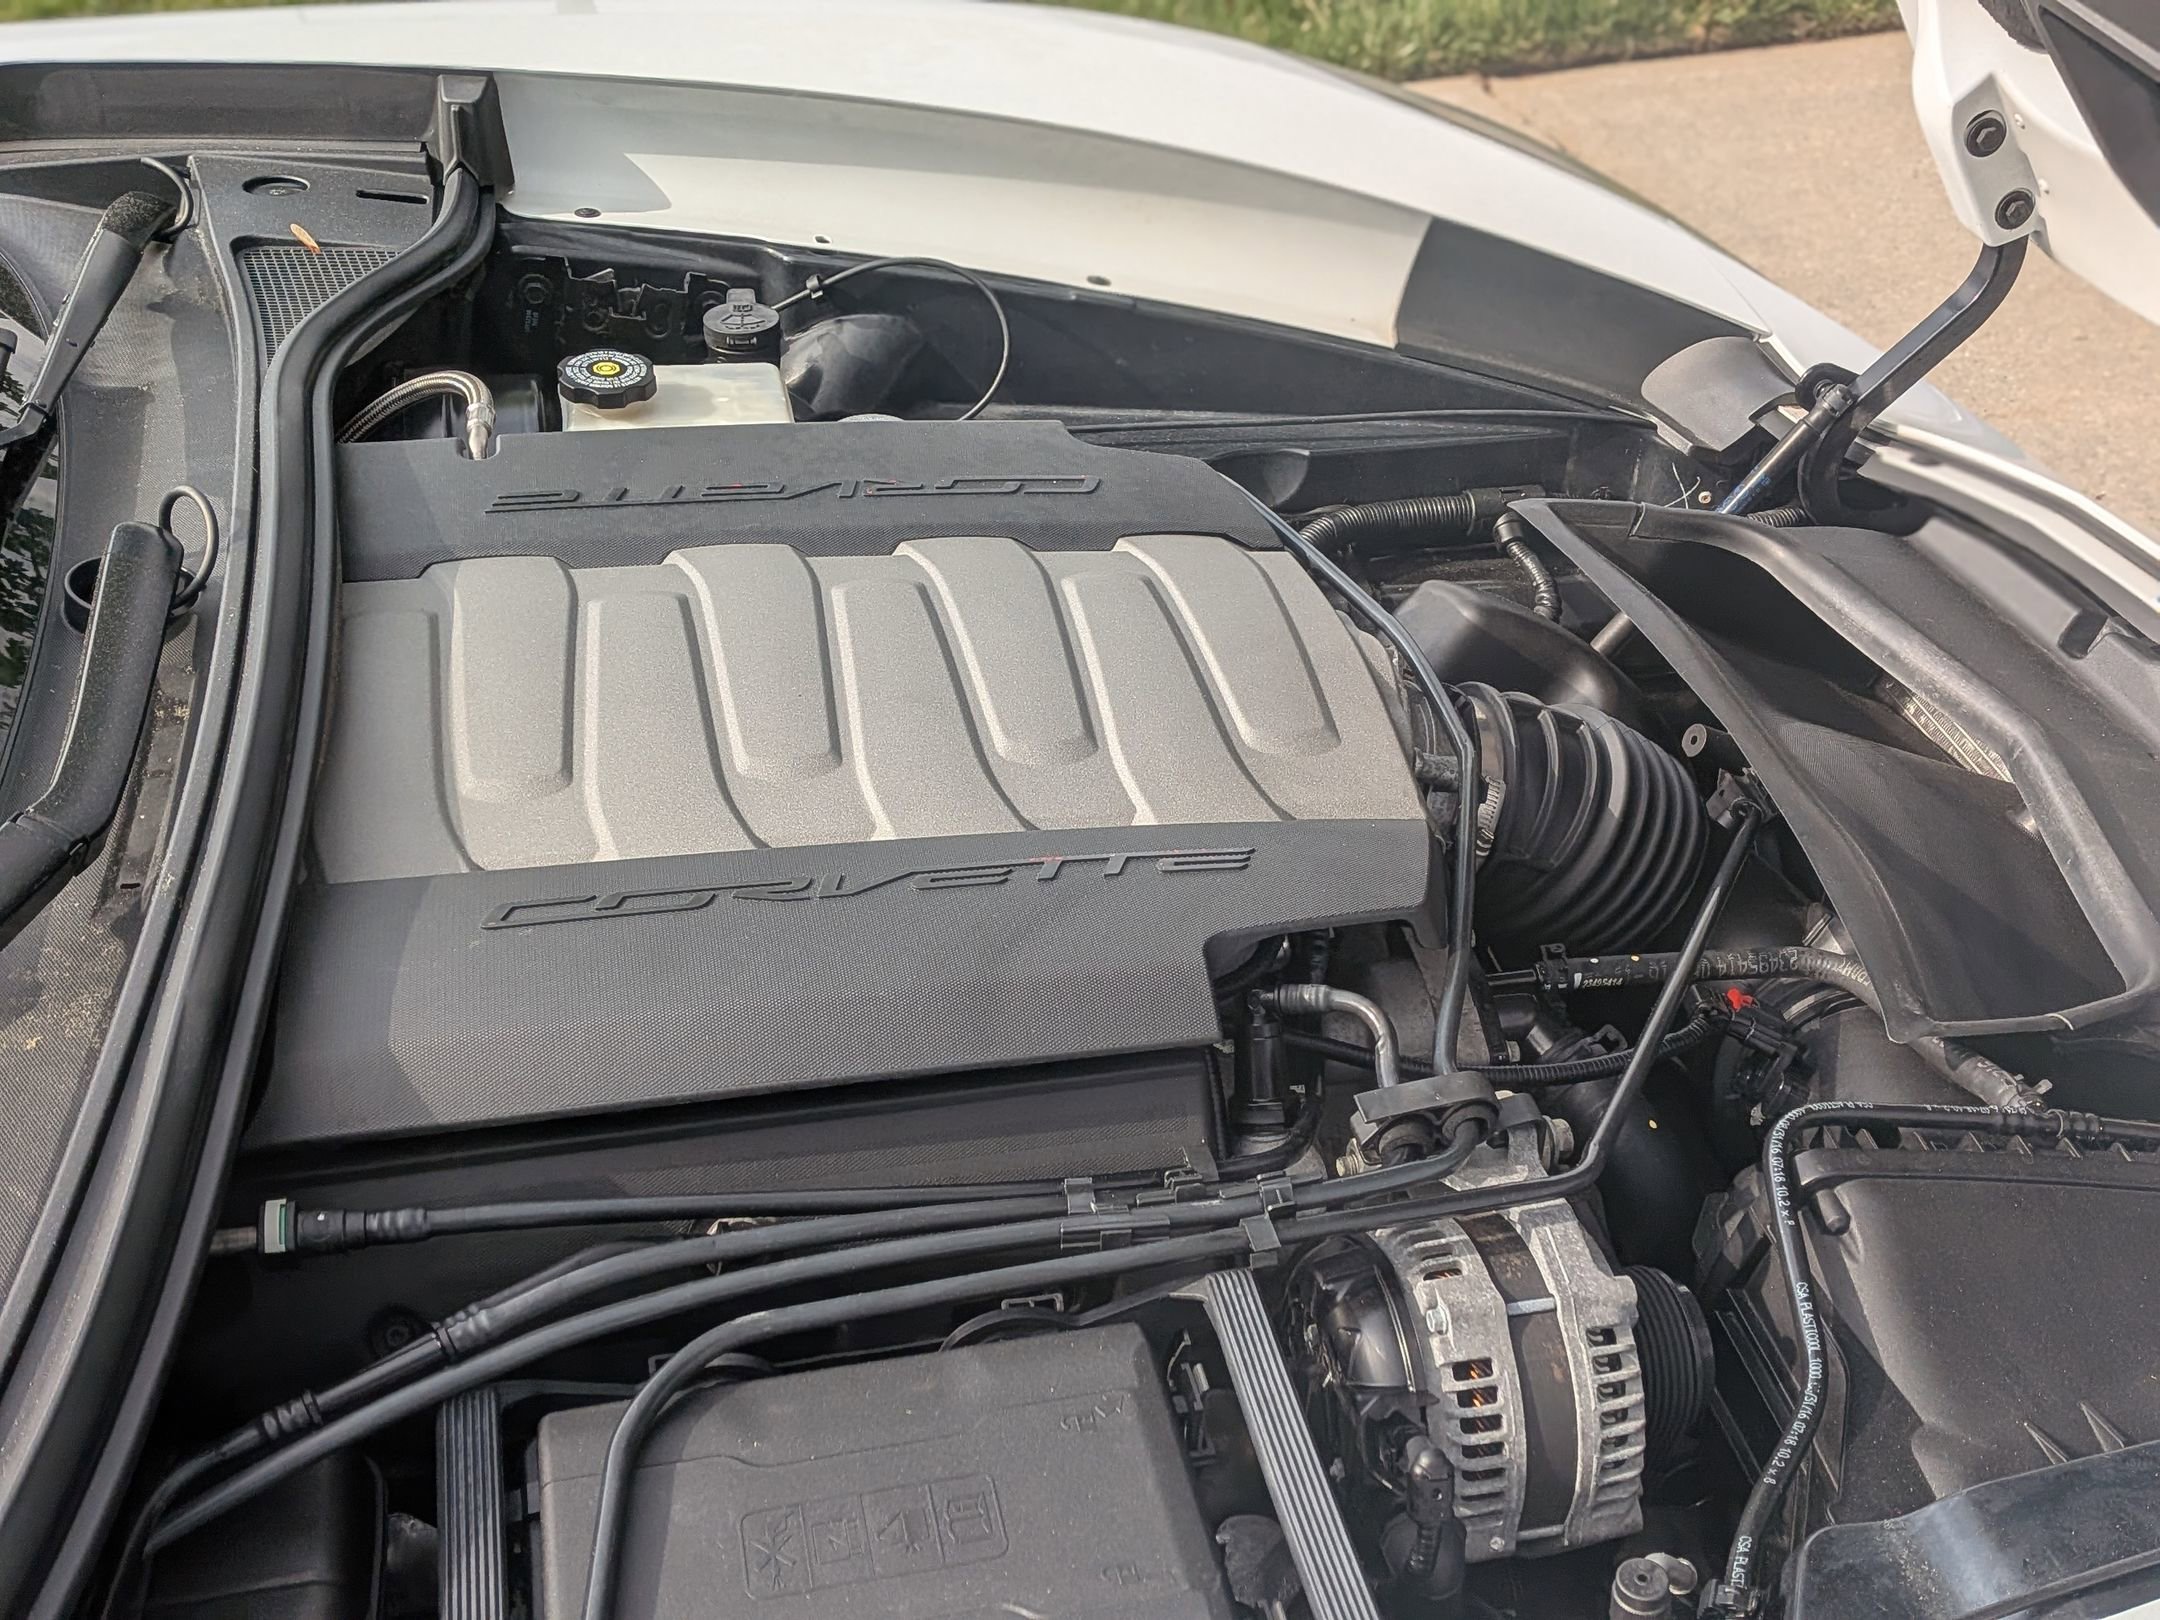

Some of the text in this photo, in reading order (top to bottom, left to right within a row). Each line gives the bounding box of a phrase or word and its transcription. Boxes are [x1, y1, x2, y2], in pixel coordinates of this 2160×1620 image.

[483, 475, 1102, 514] CORVETTE
[481, 847, 1255, 930] CORVETTE
[1795, 1281, 1810, 1300] CSA
[1809, 1357, 1823, 1379] 1000
[1783, 1420, 1807, 1447] 07:18
[1771, 1448, 1792, 1468] 10.2
[1763, 1476, 1777, 1486] 8
[1736, 1535, 1753, 1553] CSA
